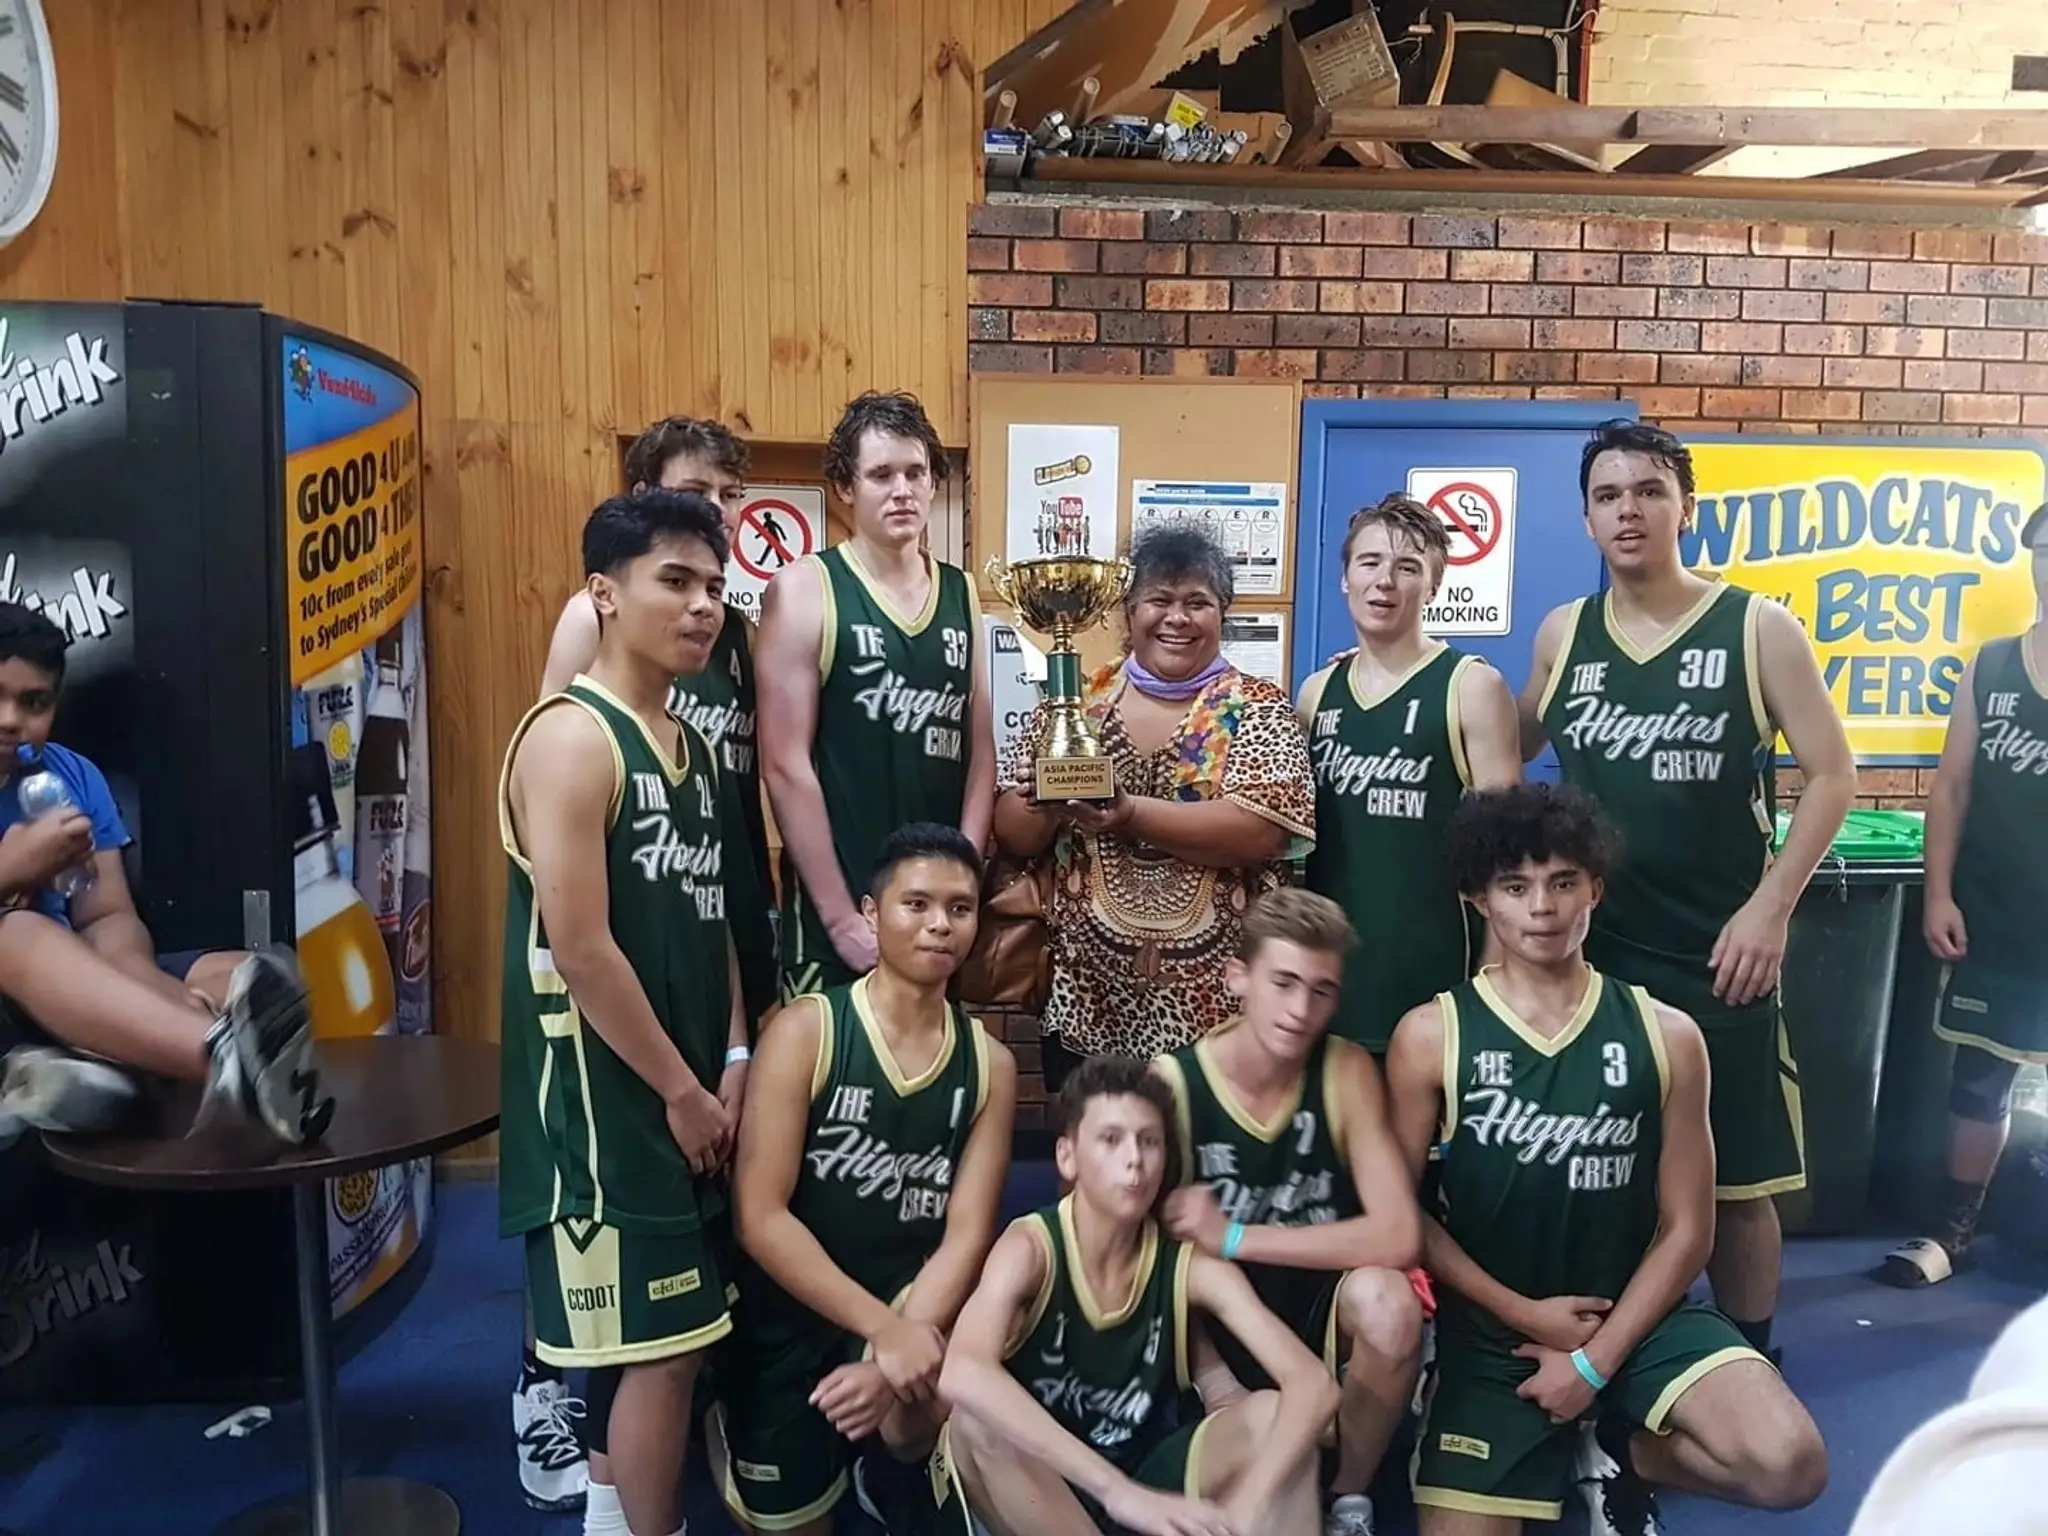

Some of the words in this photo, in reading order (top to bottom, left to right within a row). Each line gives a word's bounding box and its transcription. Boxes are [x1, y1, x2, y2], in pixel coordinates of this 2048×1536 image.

[0, 331, 119, 438] rink
[297, 451, 376, 524] GOOD
[380, 451, 388, 482] 4
[389, 436, 400, 483] U
[1680, 477, 2022, 565] WILDCATS
[298, 506, 377, 583] GOOD
[381, 504, 389, 536] 4
[300, 592, 323, 621] 10c
[325, 578, 355, 609] from
[728, 591, 754, 605] NO
[1447, 586, 1473, 603] NO
[1814, 567, 1981, 644] BEST
[301, 634, 313, 657] to
[317, 600, 367, 650] Sydney's
[942, 627, 967, 670] 33
[1569, 661, 1610, 695] THE
[1677, 648, 1728, 689] 30
[1315, 708, 1343, 738] THE
[1404, 699, 1421, 734] 1
[1986, 692, 2021, 717] THE
[1561, 695, 1731, 761] Higgins
[1044, 764, 1065, 773] ASIA
[1069, 763, 1105, 773] PACIFIC
[1046, 774, 1104, 785] CHAMPIONS
[1311, 738, 1434, 796] Higgins
[1651, 749, 1725, 781] CREW
[1366, 787, 1428, 819] CREW
[1471, 1050, 1513, 1087] THE
[1602, 1041, 1628, 1087] 3
[827, 1085, 874, 1124] THE
[1462, 1087, 1643, 1165] Higgins
[1567, 1152, 1638, 1190] CREW
[567, 1284, 616, 1311] CCDOT
